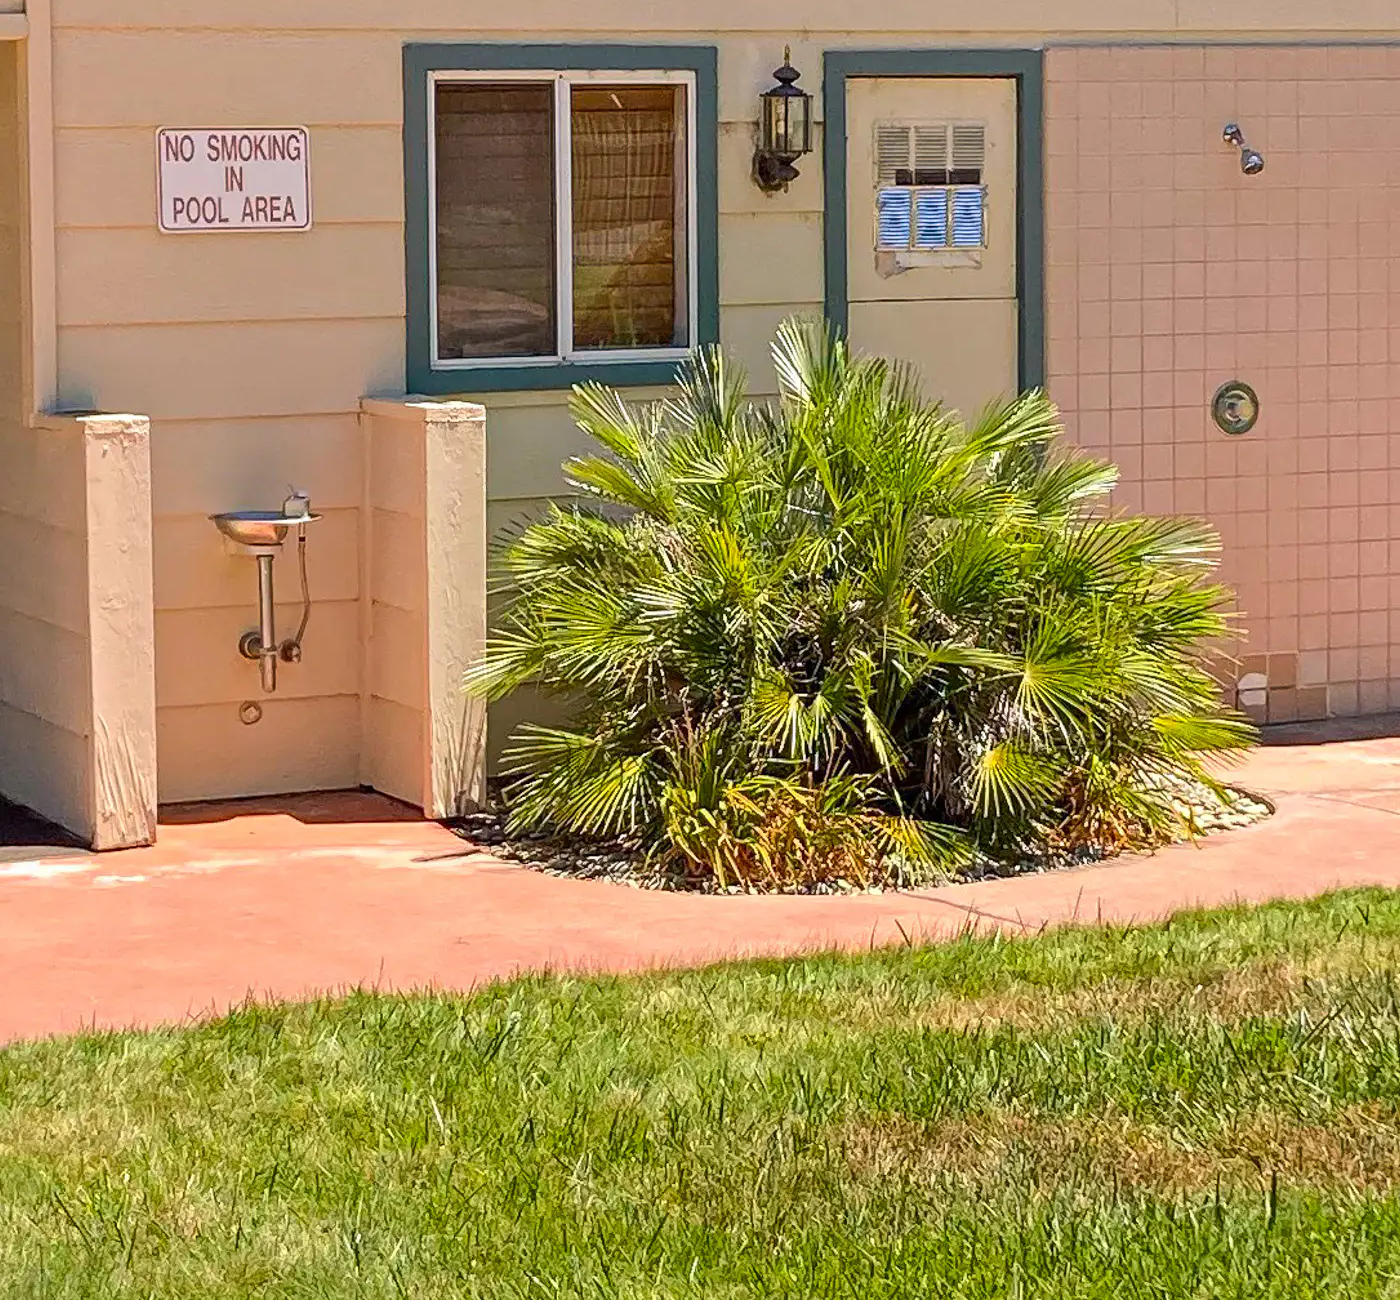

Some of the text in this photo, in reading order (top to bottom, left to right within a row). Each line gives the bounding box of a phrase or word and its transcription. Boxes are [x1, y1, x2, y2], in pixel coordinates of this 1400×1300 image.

[165, 134, 301, 162] NO SMOKING
[225, 166, 243, 192] IN
[173, 196, 296, 223] POOL AREA
